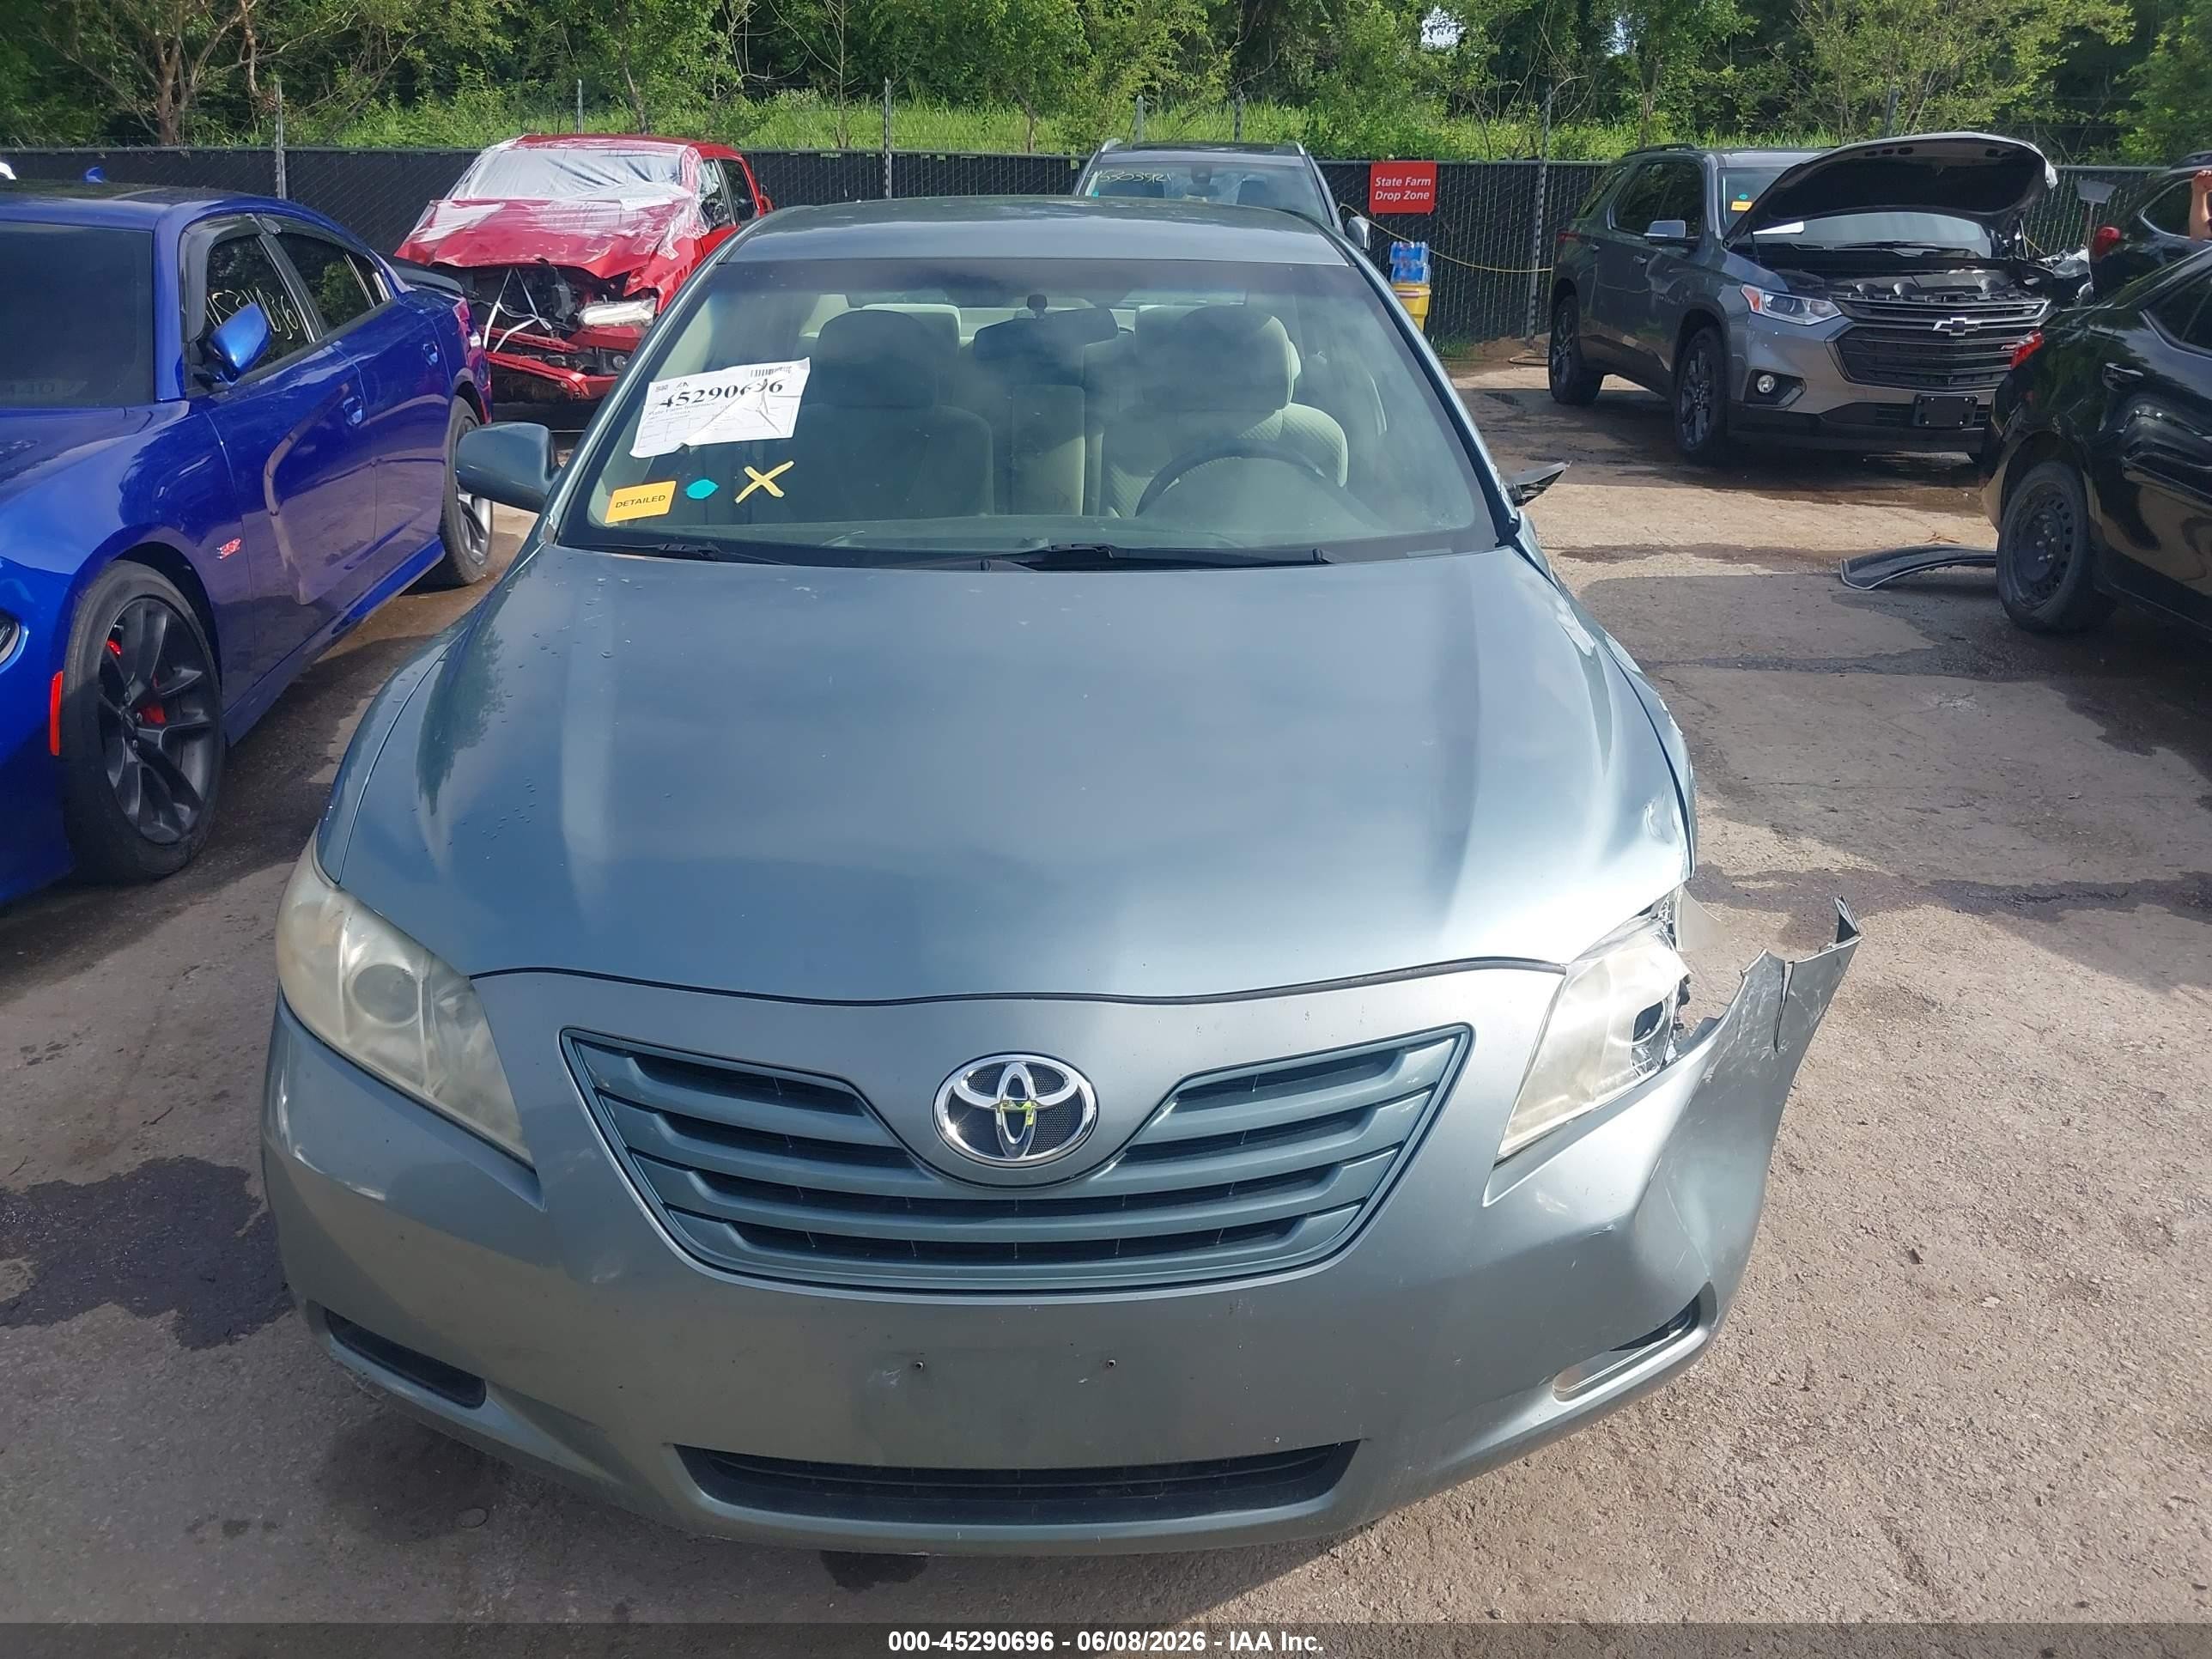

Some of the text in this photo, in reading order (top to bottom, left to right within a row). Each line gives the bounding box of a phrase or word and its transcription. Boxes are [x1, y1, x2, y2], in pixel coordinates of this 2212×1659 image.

[1375, 177, 1431, 187] State Farm
[1375, 191, 1430, 203] Drop Zone
[616, 495, 666, 508] DETAILED
